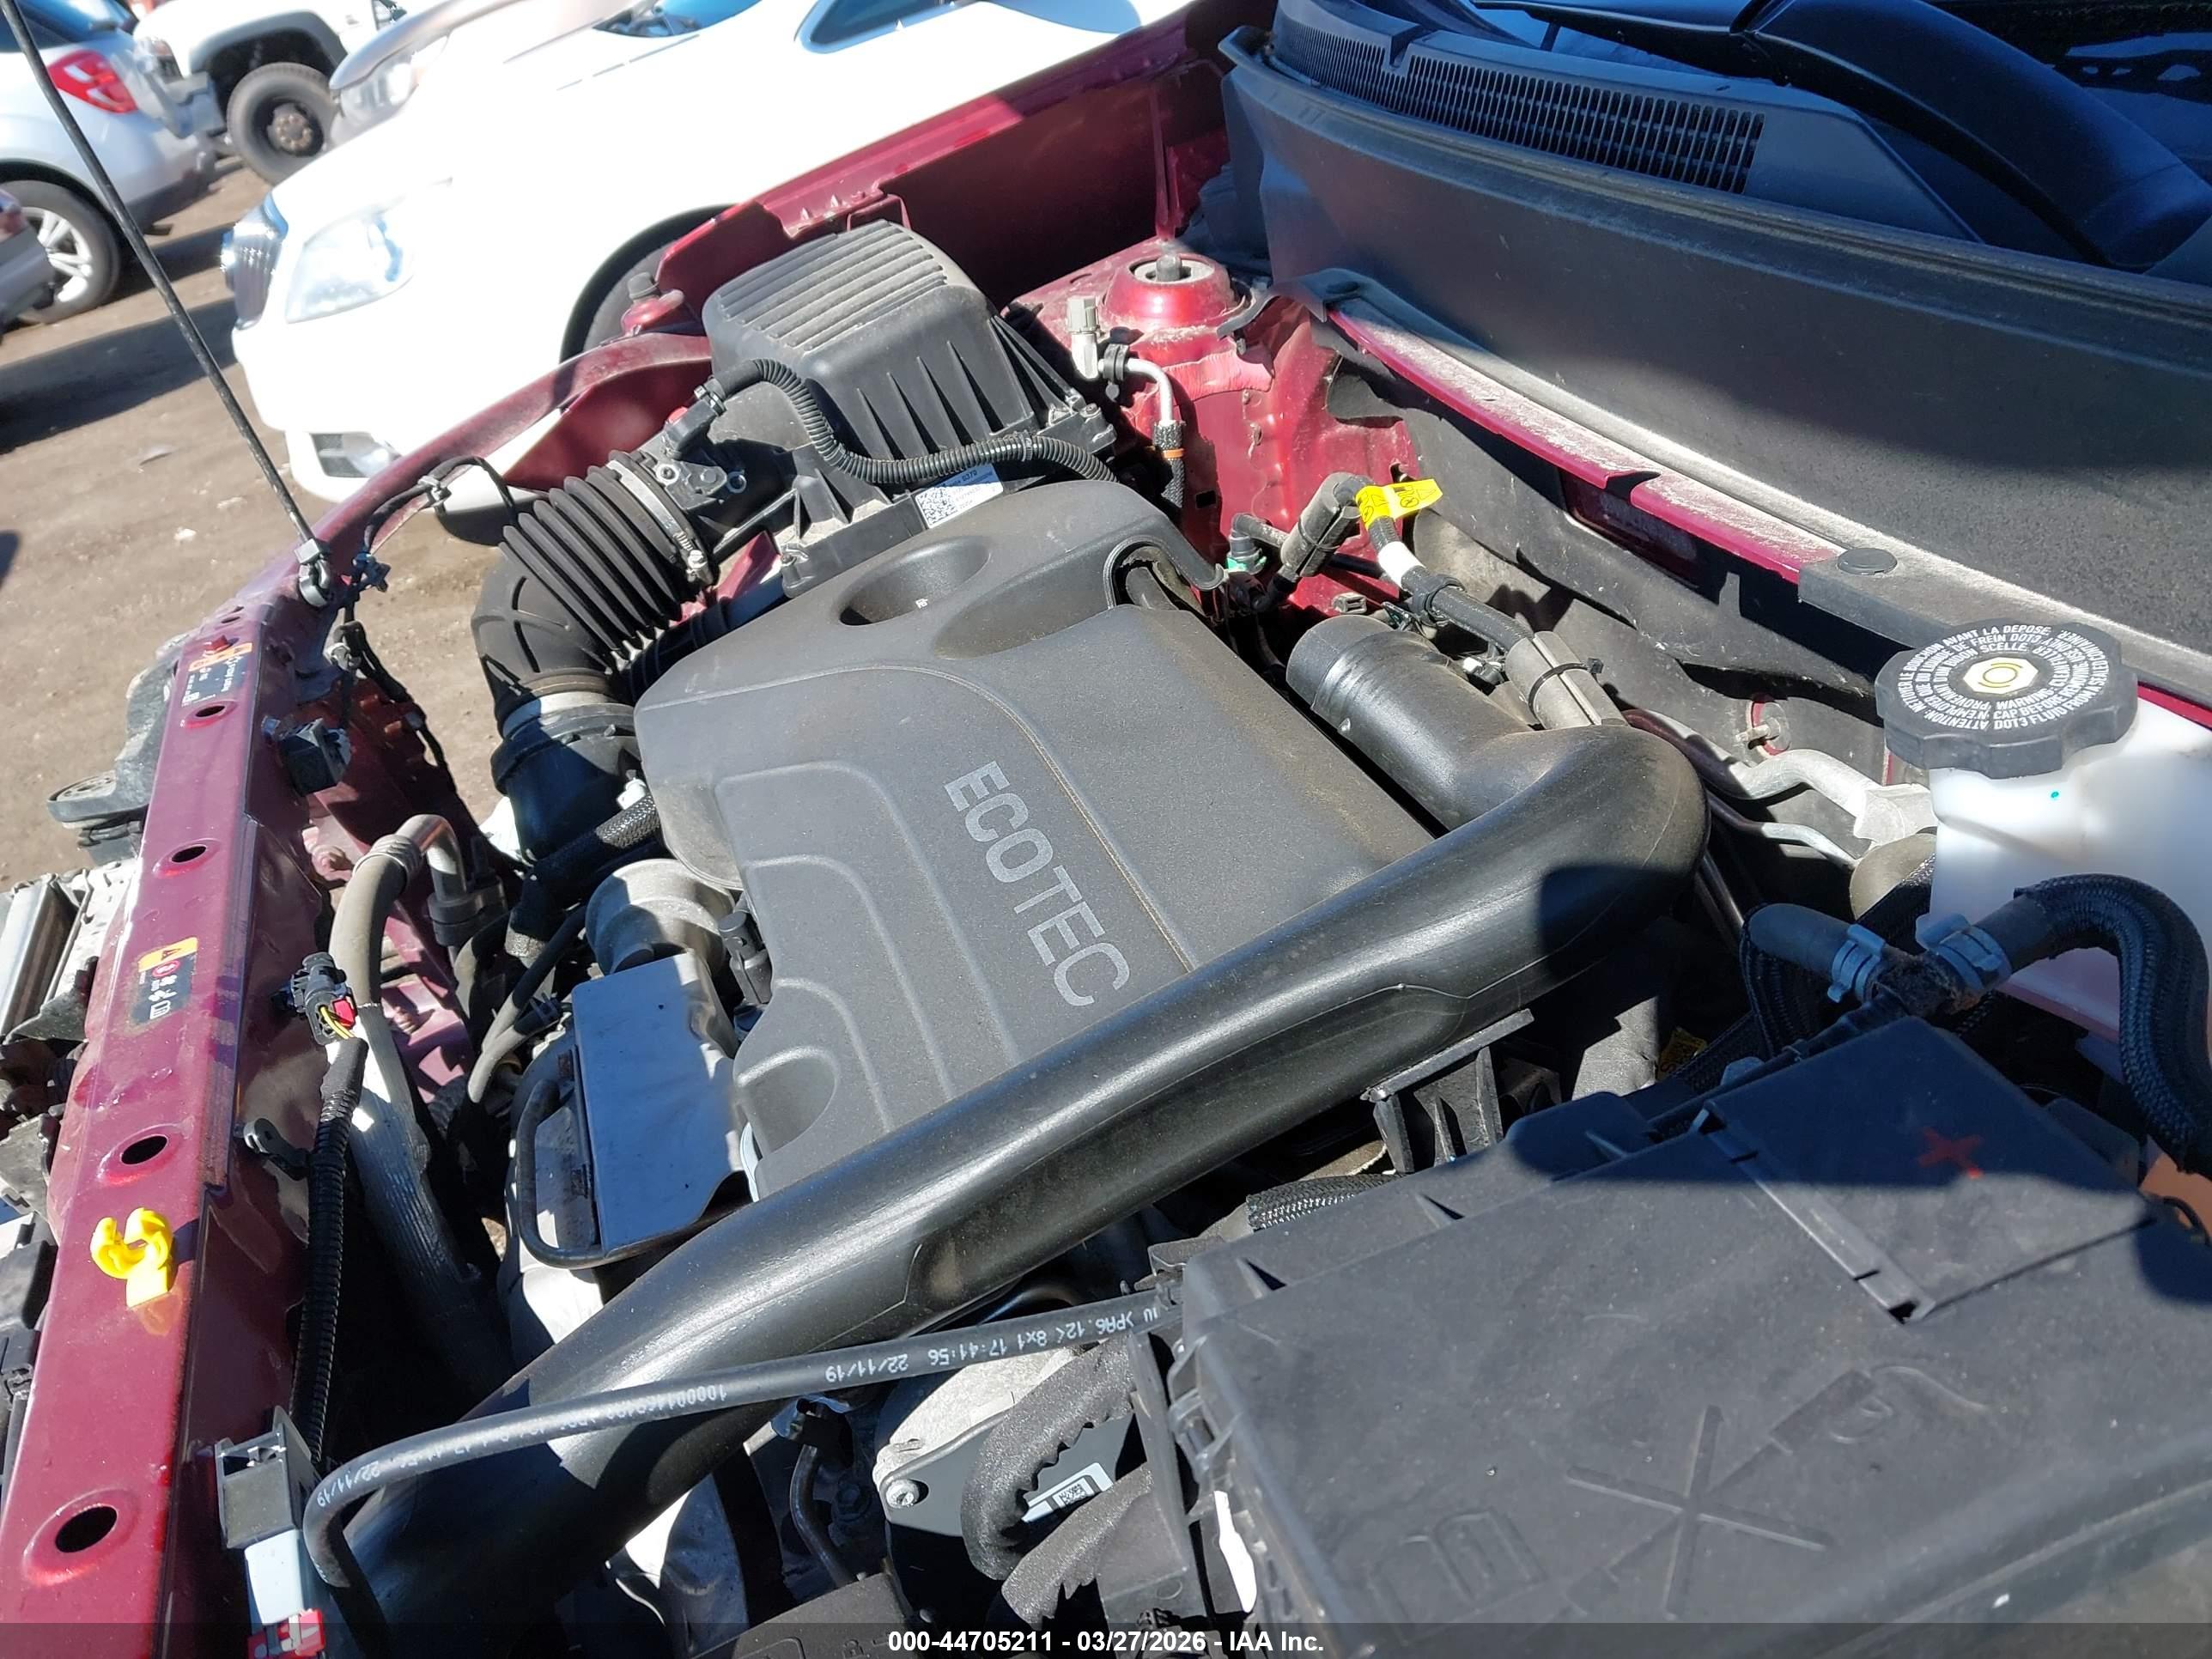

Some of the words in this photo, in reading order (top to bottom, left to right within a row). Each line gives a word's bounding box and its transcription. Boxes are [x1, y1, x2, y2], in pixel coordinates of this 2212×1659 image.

[1942, 629, 1979, 647] AVANT
[1982, 626, 2000, 635] LA
[1951, 641, 1971, 653] DE
[1970, 634, 2007, 647] FREIN
[1923, 708, 1990, 730] ATTENTION:
[1993, 708, 2018, 720] CAP
[1993, 716, 2029, 730] DOT3
[2027, 706, 2069, 724] FLUID
[944, 761, 1131, 1007] ECOTEC
[927, 1339, 1008, 1365] 17:41:56
[1018, 1330, 1048, 1352] 8x1
[825, 1353, 908, 1383] 22/11/19
[316, 1461, 380, 1507] 22/11/19
